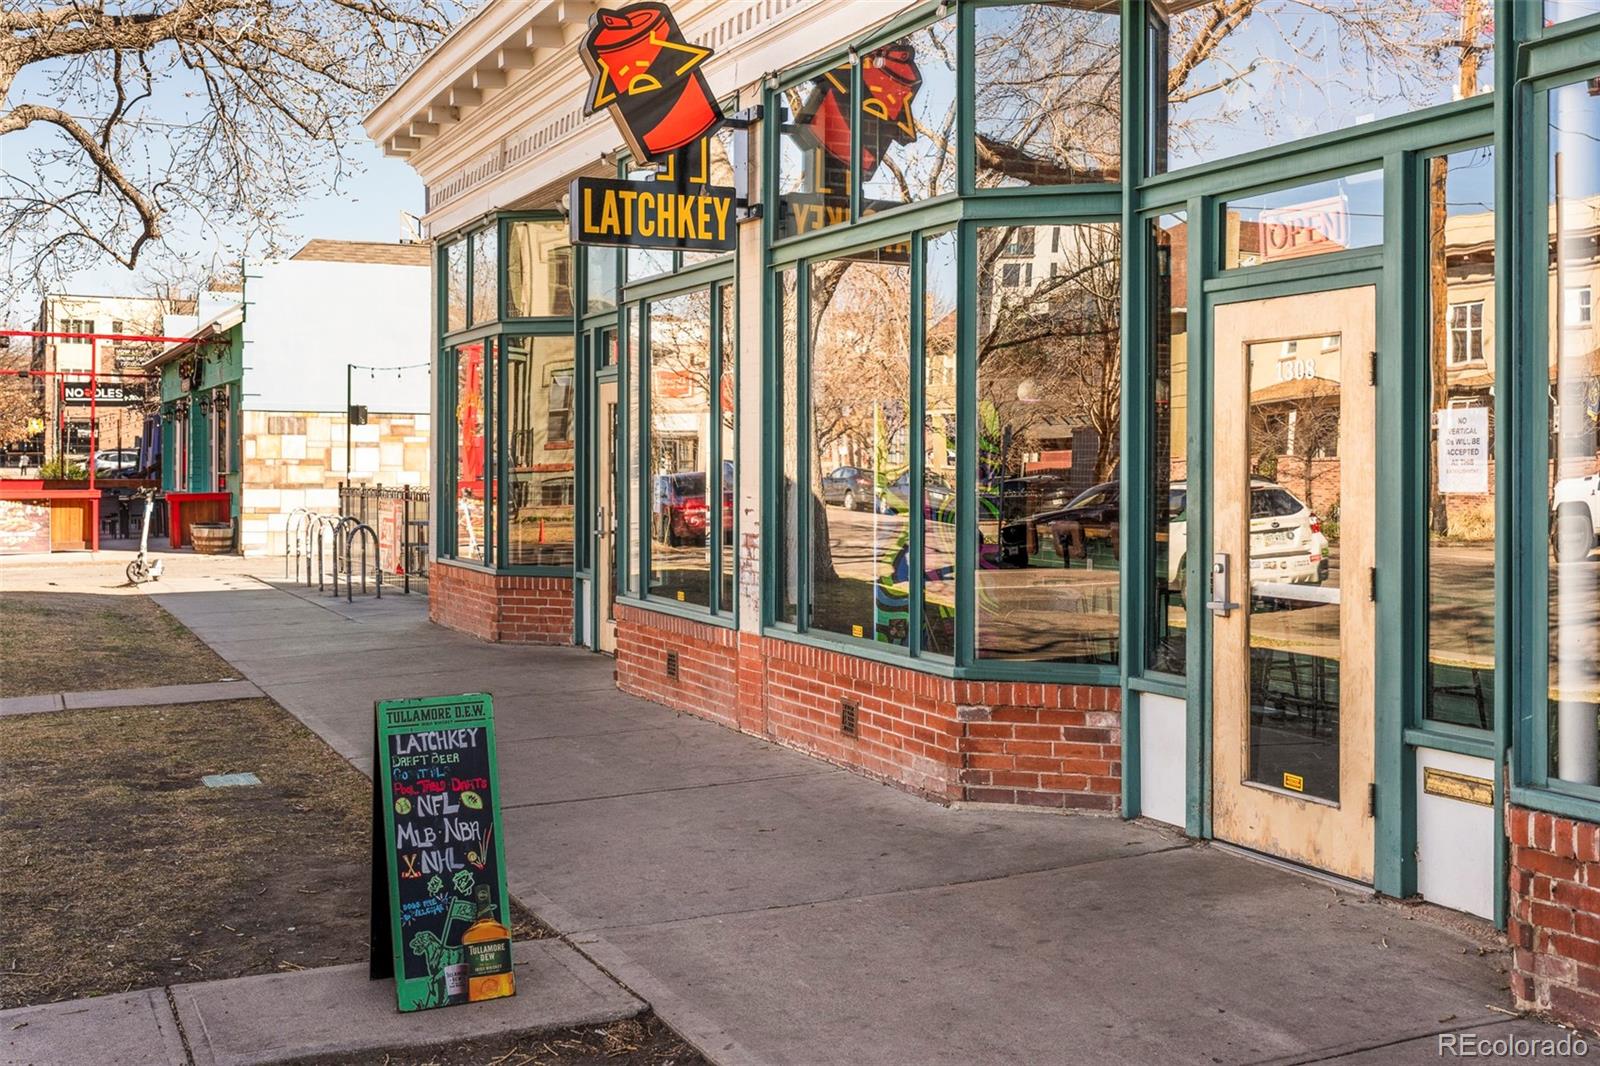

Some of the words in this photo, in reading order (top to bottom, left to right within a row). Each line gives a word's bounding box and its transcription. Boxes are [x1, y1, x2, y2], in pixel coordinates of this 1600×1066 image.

[583, 187, 731, 241] LATCHKEY
[1268, 211, 1343, 250] OPEN
[1457, 417, 1467, 425] NO
[1471, 437, 1481, 445] BE
[1447, 448, 1480, 456] ACCEPTED
[386, 707, 452, 724] TULLAMORE
[455, 704, 486, 719] D.E.W.
[395, 727, 479, 755] LATCHKEY
[431, 752, 460, 764] BEER
[417, 792, 460, 817] NFL
[397, 821, 437, 849] MLB
[443, 817, 481, 843] NBA
[421, 847, 465, 874] NHL
[468, 943, 505, 956] TULLAMORE
[480, 953, 496, 962] DEW
